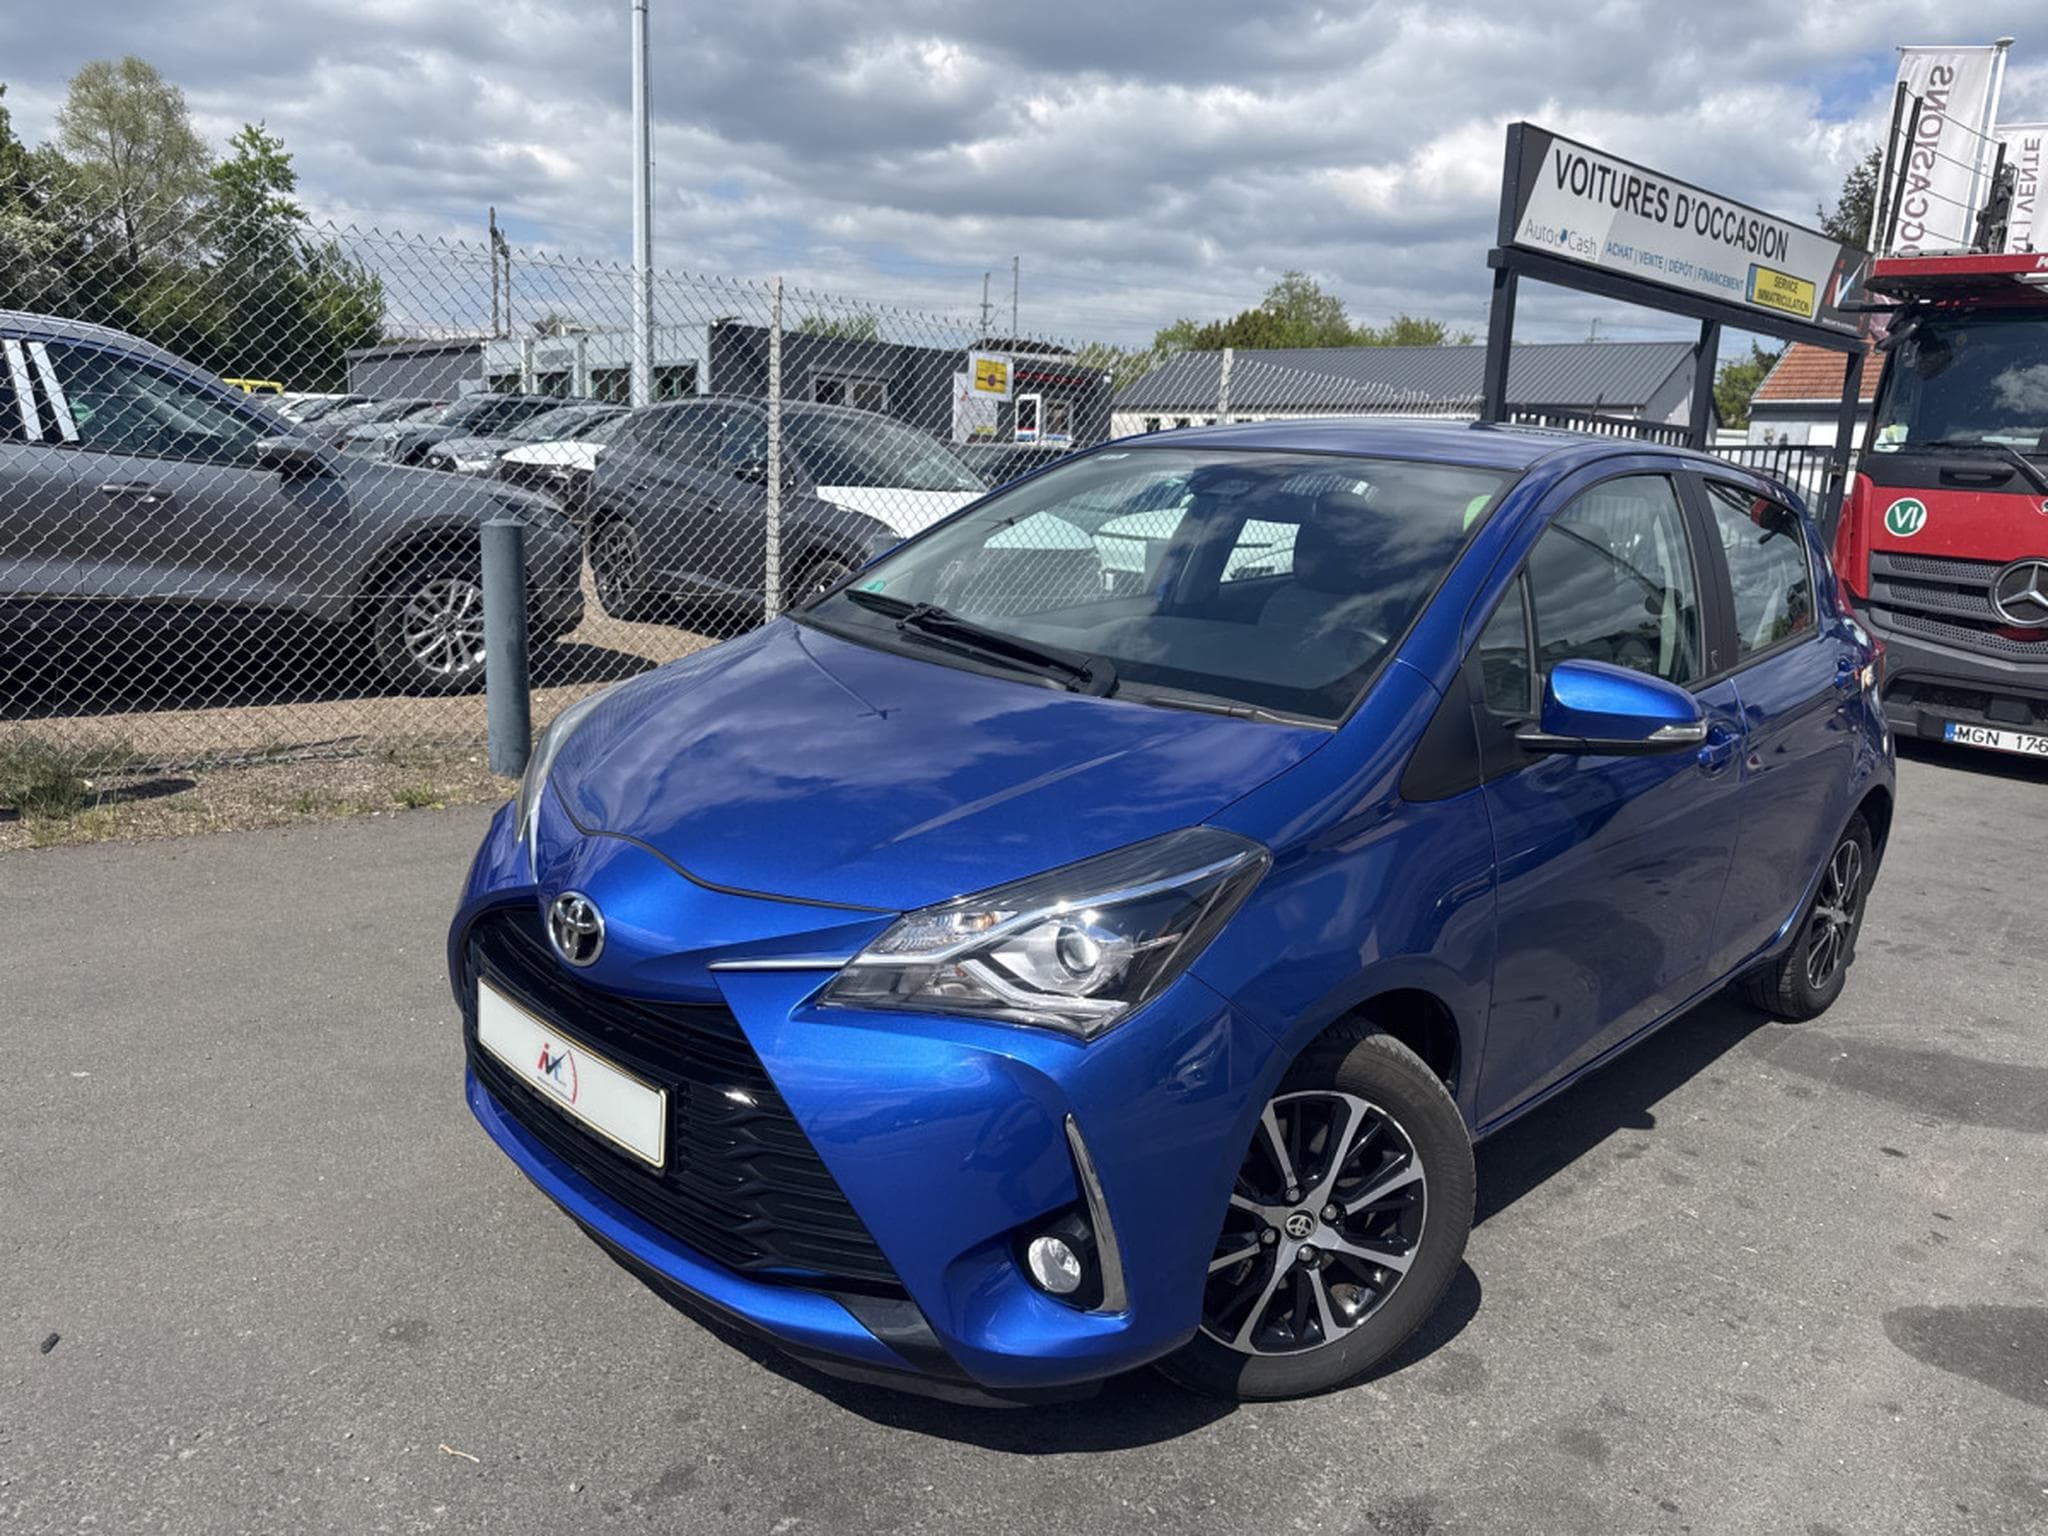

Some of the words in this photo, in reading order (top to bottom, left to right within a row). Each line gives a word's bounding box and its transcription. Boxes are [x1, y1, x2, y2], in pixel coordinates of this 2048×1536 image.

[1555, 148, 1668, 223] VOITURES
[1674, 193, 1789, 263] D'OCCASION
[1524, 218, 1554, 244] Auto
[1568, 231, 1597, 256] Cash
[1606, 241, 1633, 260] ACHAT
[1640, 250, 1664, 270] VENTE
[1699, 267, 1744, 292] FINANCEMENT
[1774, 275, 1799, 294] SERVICE
[1957, 726, 2000, 746] MGN
